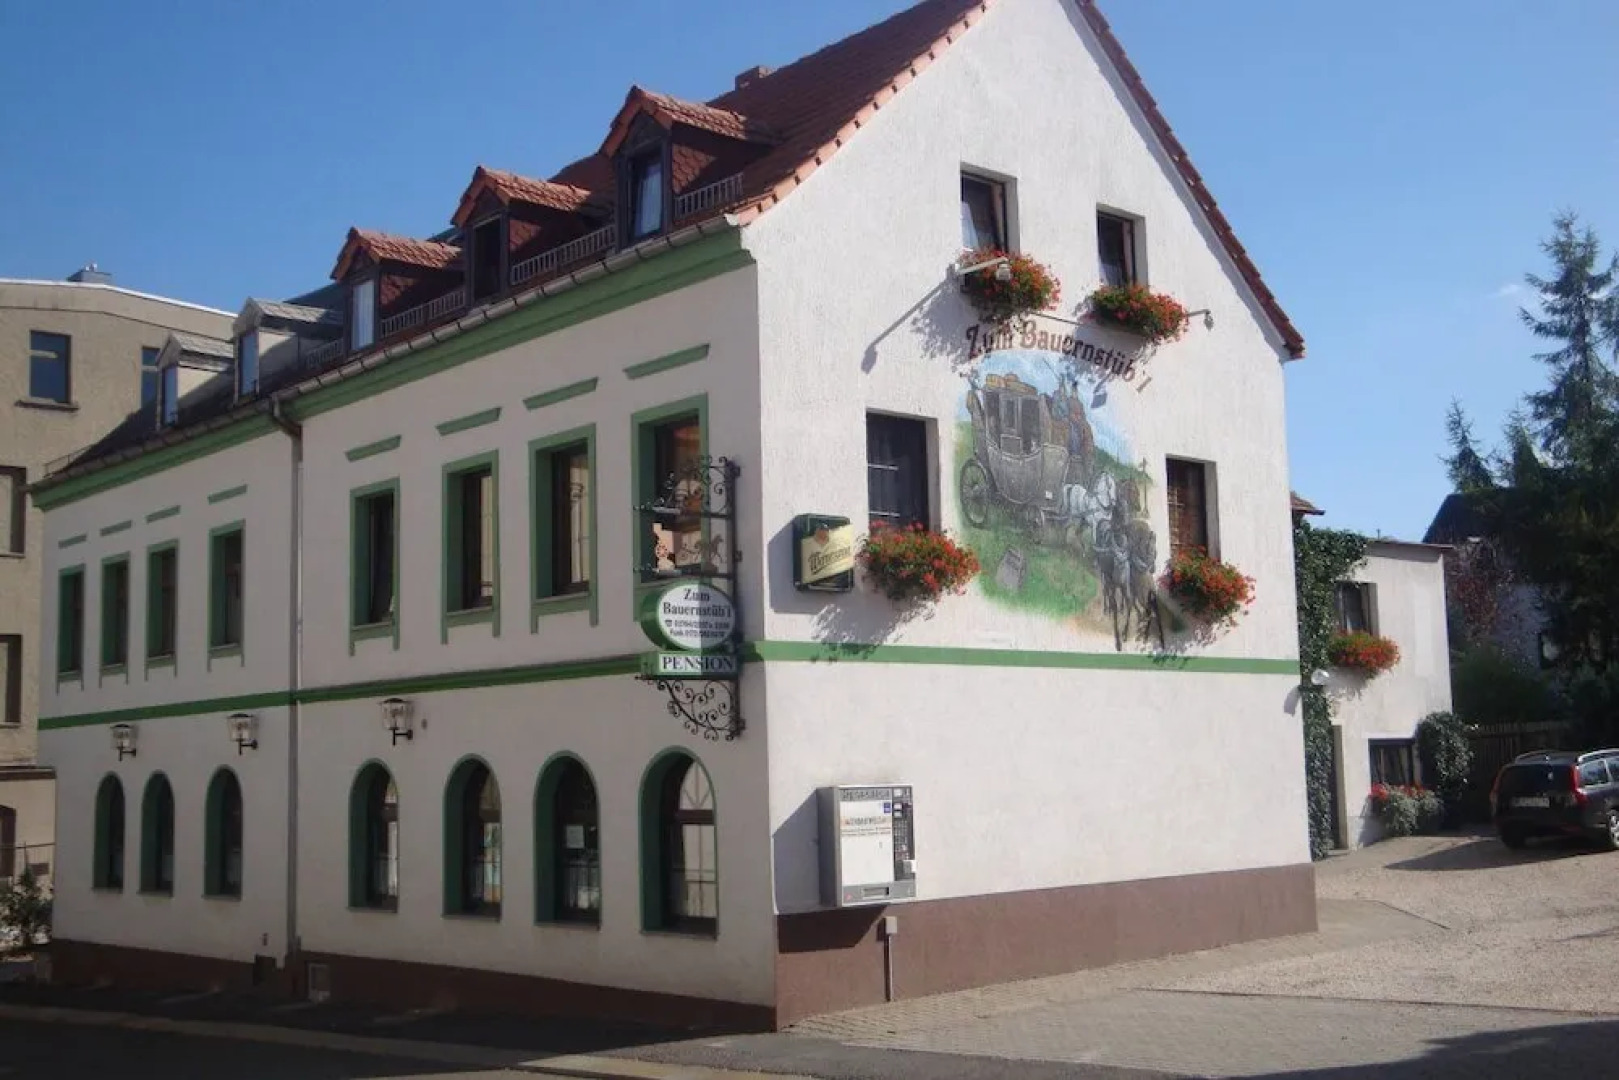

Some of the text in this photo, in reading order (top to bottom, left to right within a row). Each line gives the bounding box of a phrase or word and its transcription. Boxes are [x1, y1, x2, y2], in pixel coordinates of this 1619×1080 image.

[965, 323, 1013, 359] Zum
[684, 588, 710, 601] Zum
[663, 656, 733, 671] PENSION
